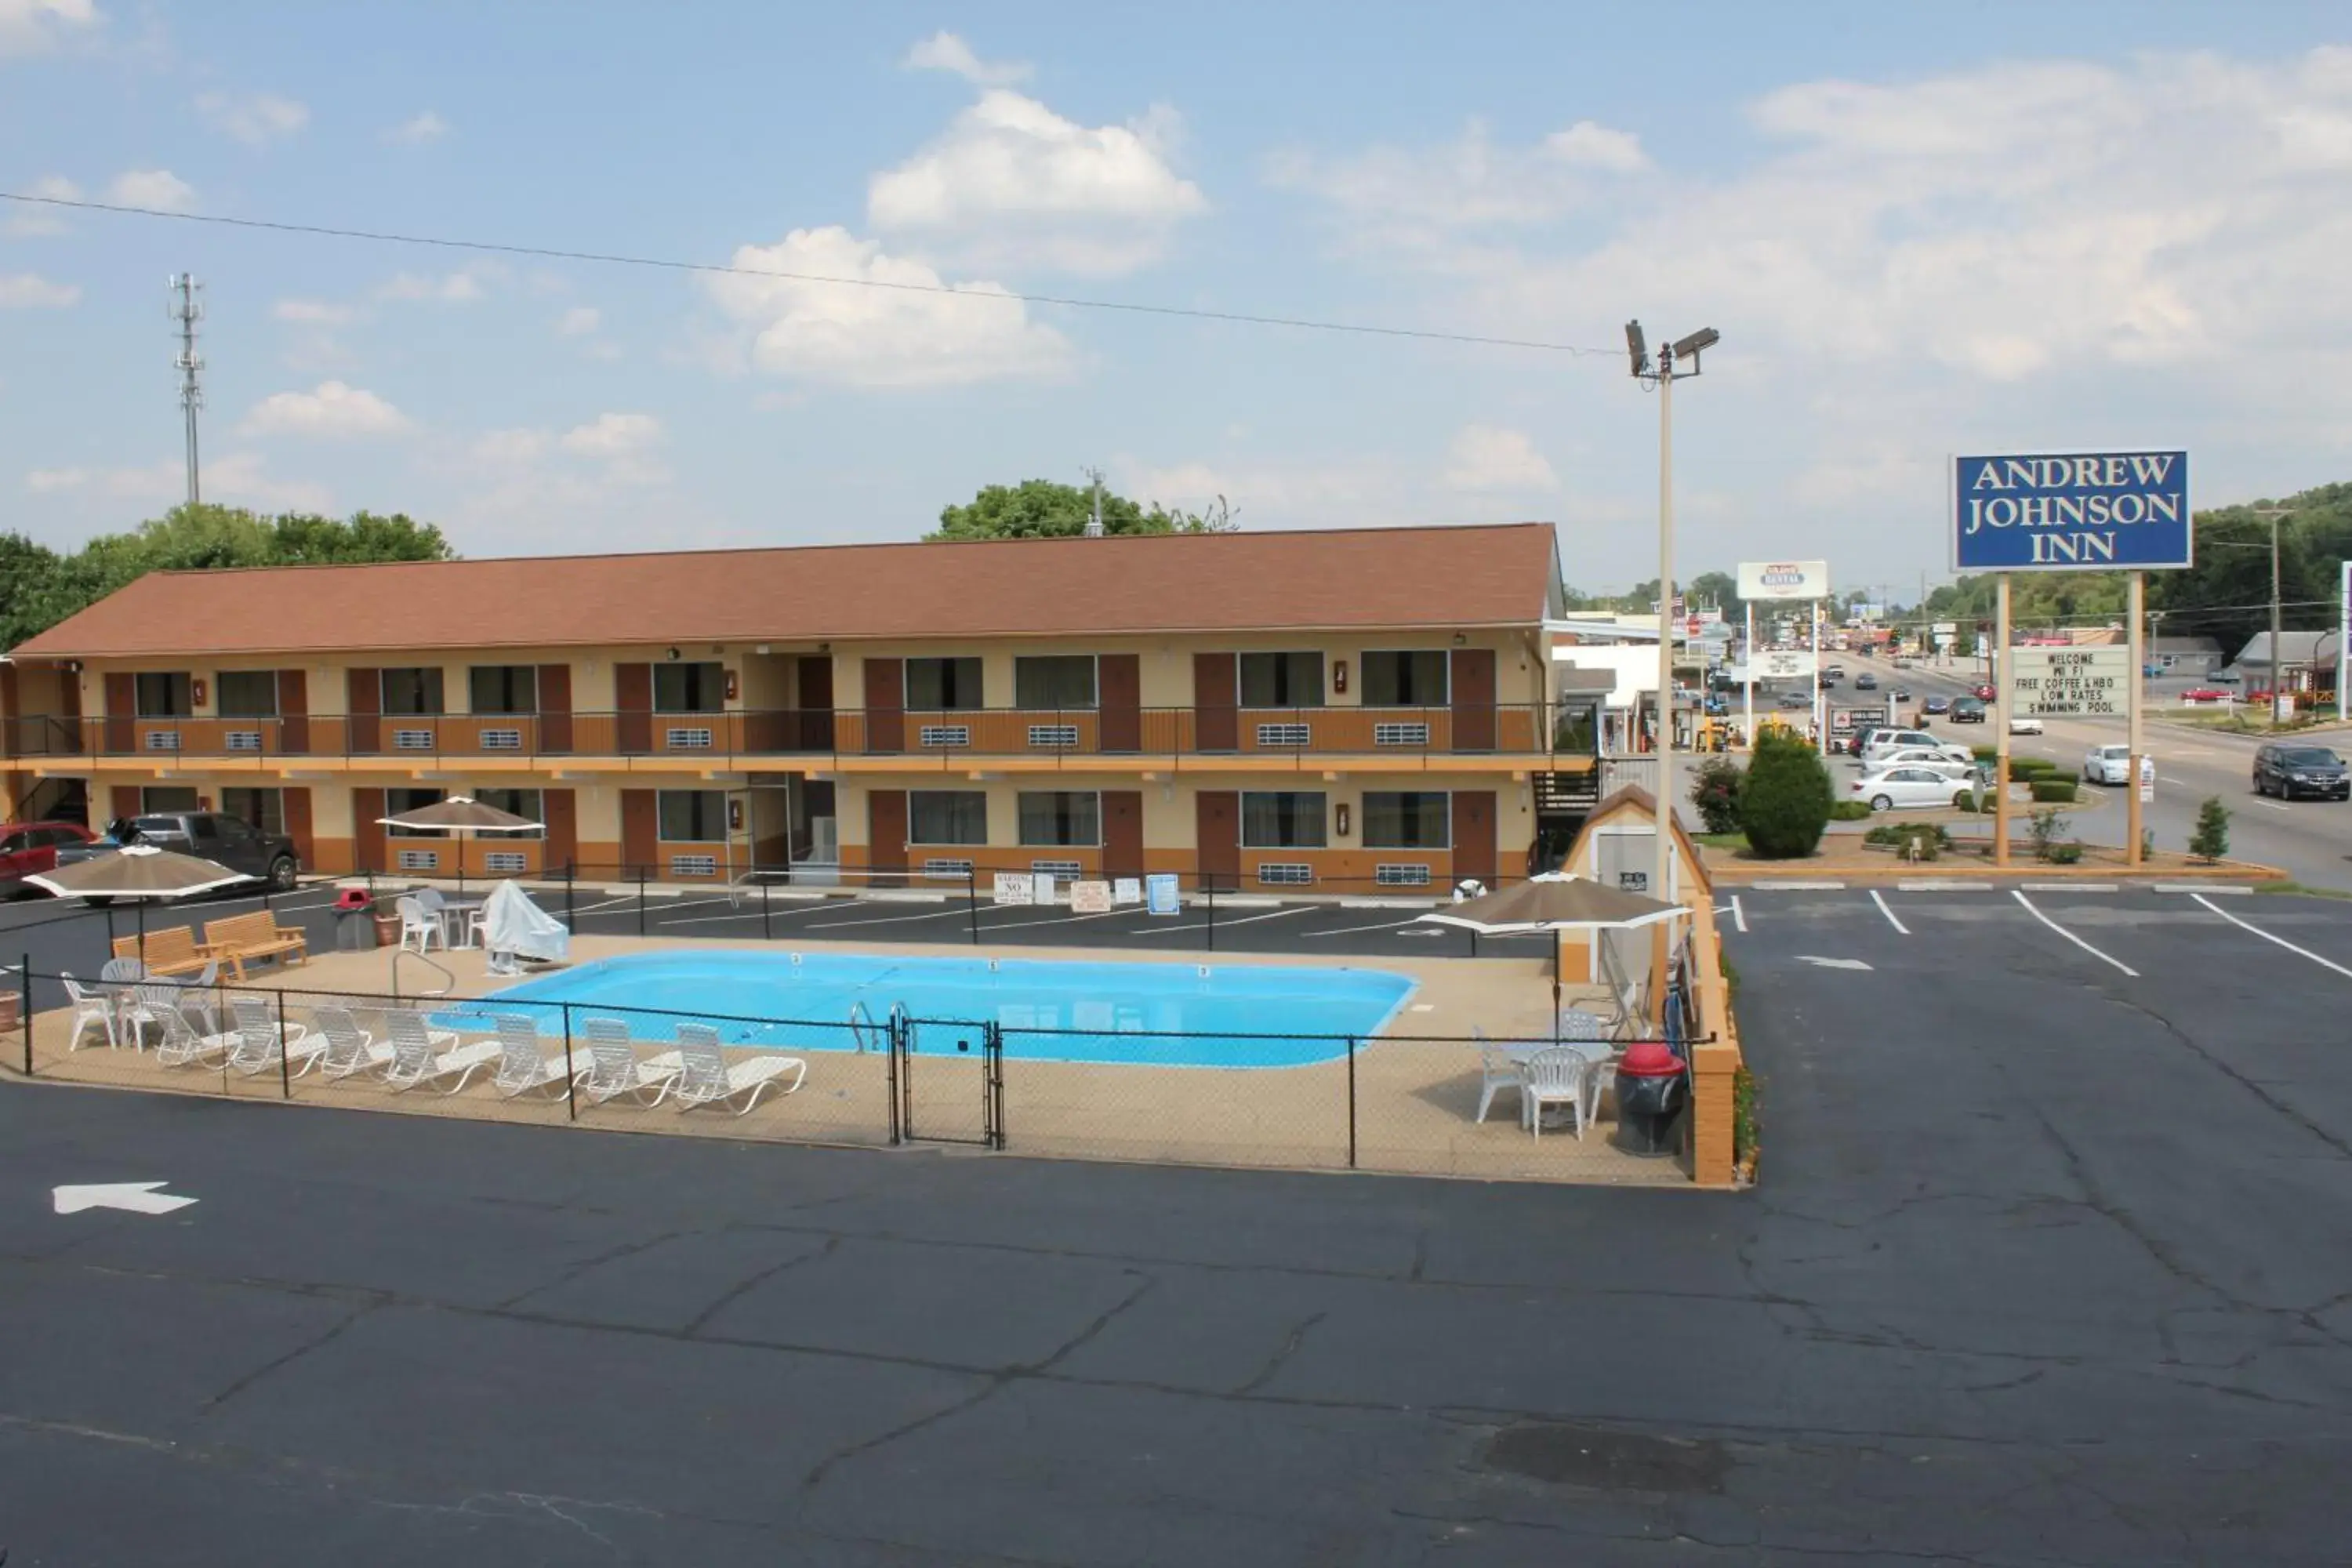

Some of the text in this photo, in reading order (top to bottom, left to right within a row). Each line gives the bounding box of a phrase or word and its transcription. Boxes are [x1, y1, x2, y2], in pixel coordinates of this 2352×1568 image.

[1973, 455, 2174, 490] ANDREW
[1965, 493, 2180, 535] JOHNSON
[2030, 532, 2115, 562] INN
[2047, 653, 2094, 665] WELCOME
[2016, 678, 2038, 689] FREE
[2044, 678, 2081, 689] COFFEE
[2040, 690, 2103, 700] LOW RATES
[2087, 702, 2114, 713] POOL
[1005, 883, 1022, 891] NO
